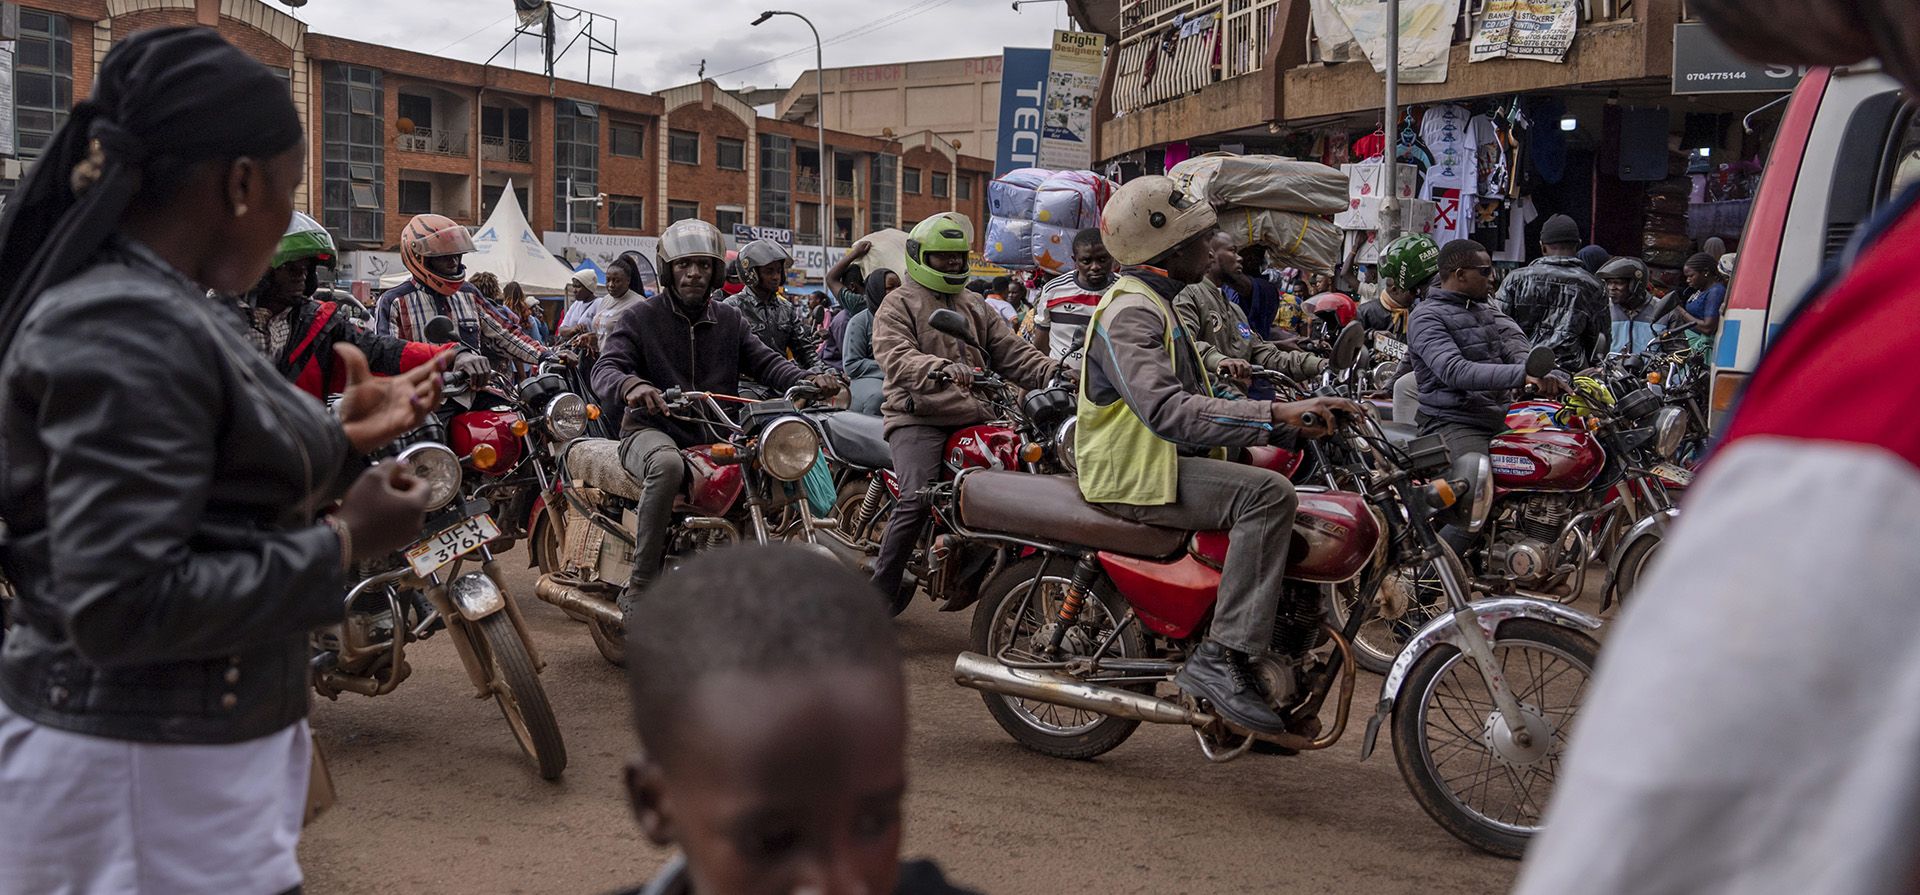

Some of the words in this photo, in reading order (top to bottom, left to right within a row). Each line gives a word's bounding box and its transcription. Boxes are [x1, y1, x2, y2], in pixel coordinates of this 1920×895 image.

[1522, 13, 1555, 22] STICKERS
[1062, 33, 1097, 47] Bright
[1054, 43, 1101, 56] Designers
[851, 65, 900, 82] FRENCH
[1686, 72, 1747, 80] 0704775144
[750, 226, 790, 243] SLEEPLO
[1387, 338, 1405, 352] UGE
[958, 437, 974, 445] TVS
[439, 519, 480, 545] UFW
[435, 530, 488, 562] 376X
